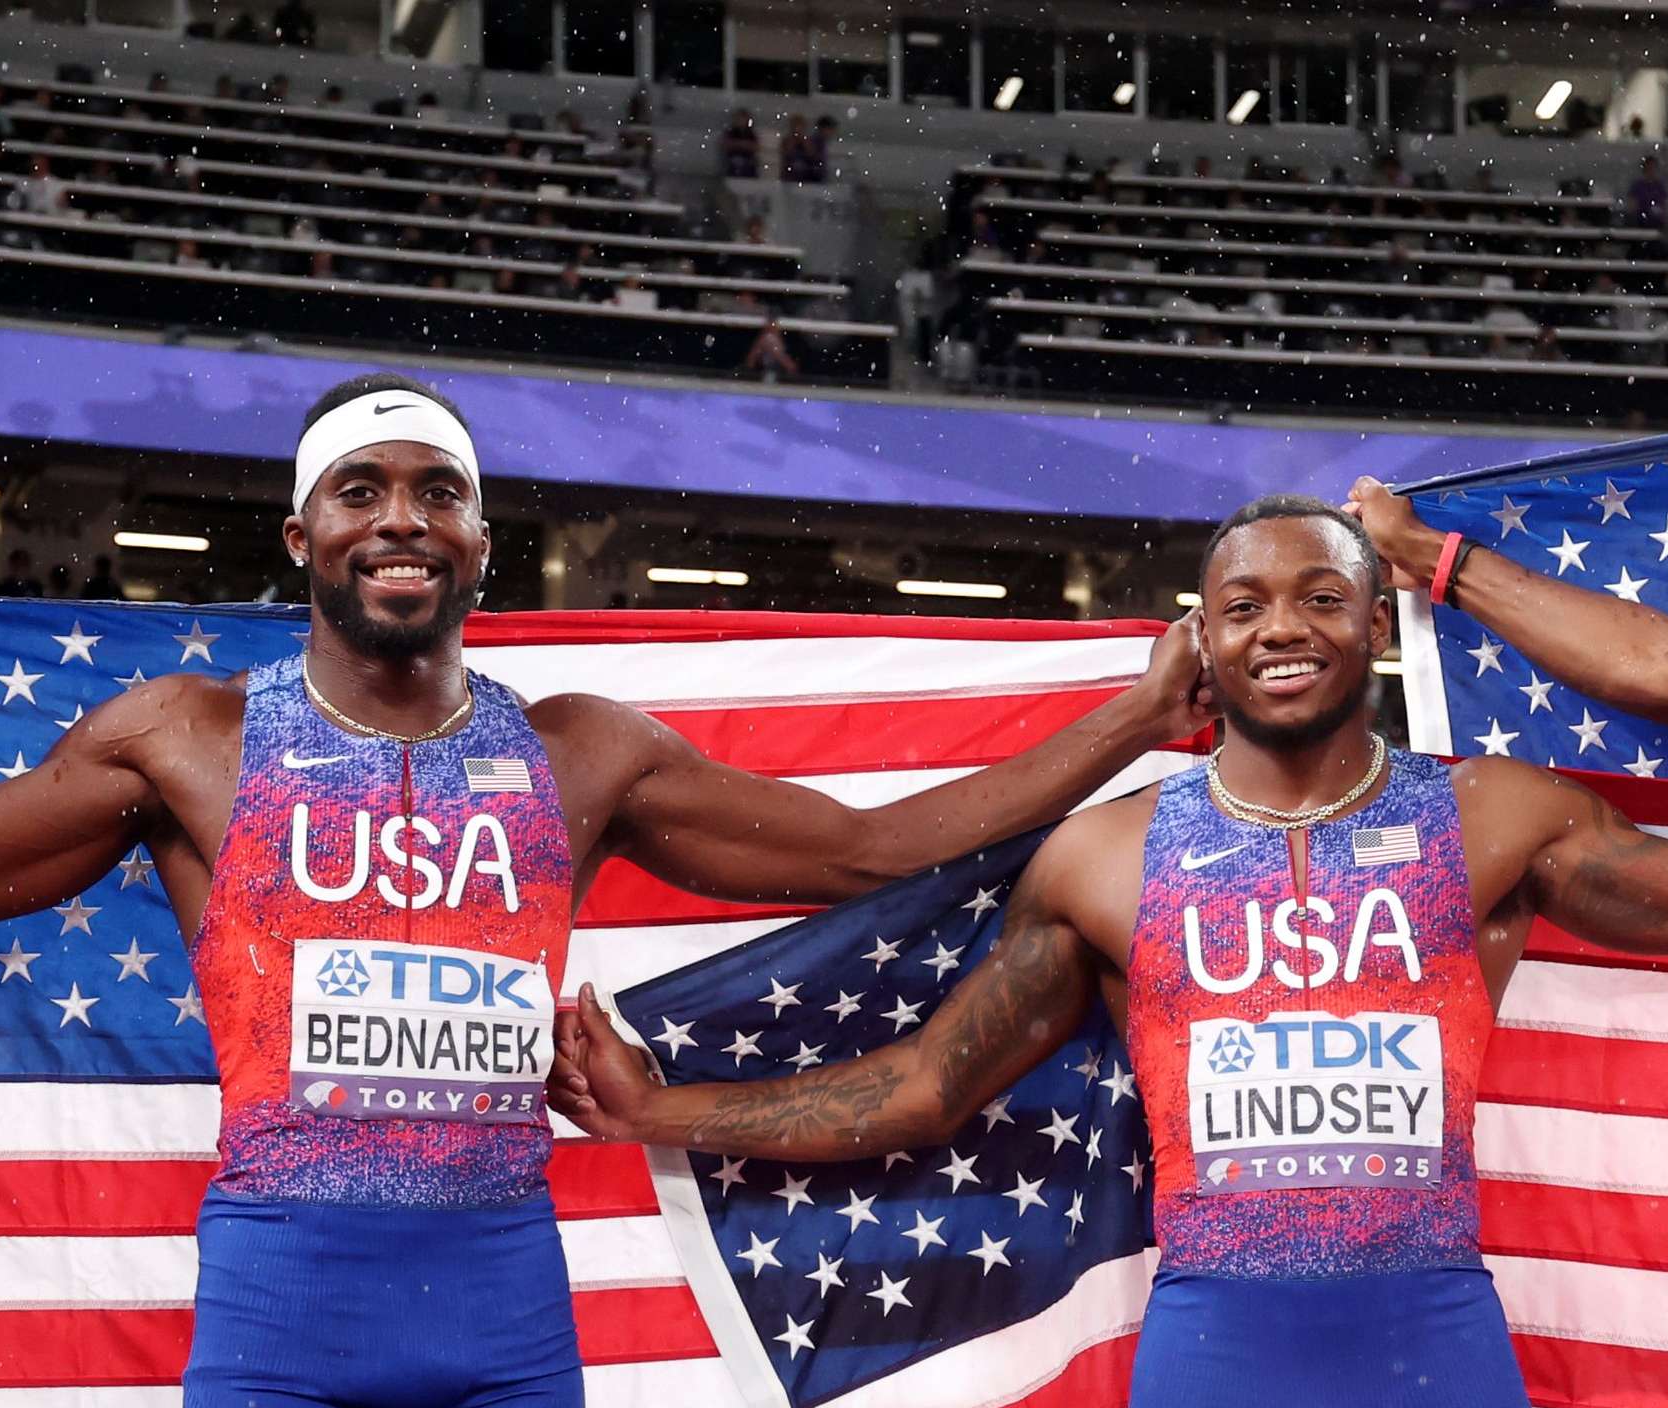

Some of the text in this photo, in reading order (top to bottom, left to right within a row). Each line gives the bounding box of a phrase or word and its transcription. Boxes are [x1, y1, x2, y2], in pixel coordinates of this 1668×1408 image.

[292, 803, 519, 913] USA
[1184, 889, 1421, 994] USA
[371, 950, 536, 1010] TDK
[307, 1013, 540, 1074] BEDNAREK
[1254, 1021, 1422, 1071] TDK
[1206, 1084, 1428, 1142] LINDSEY
